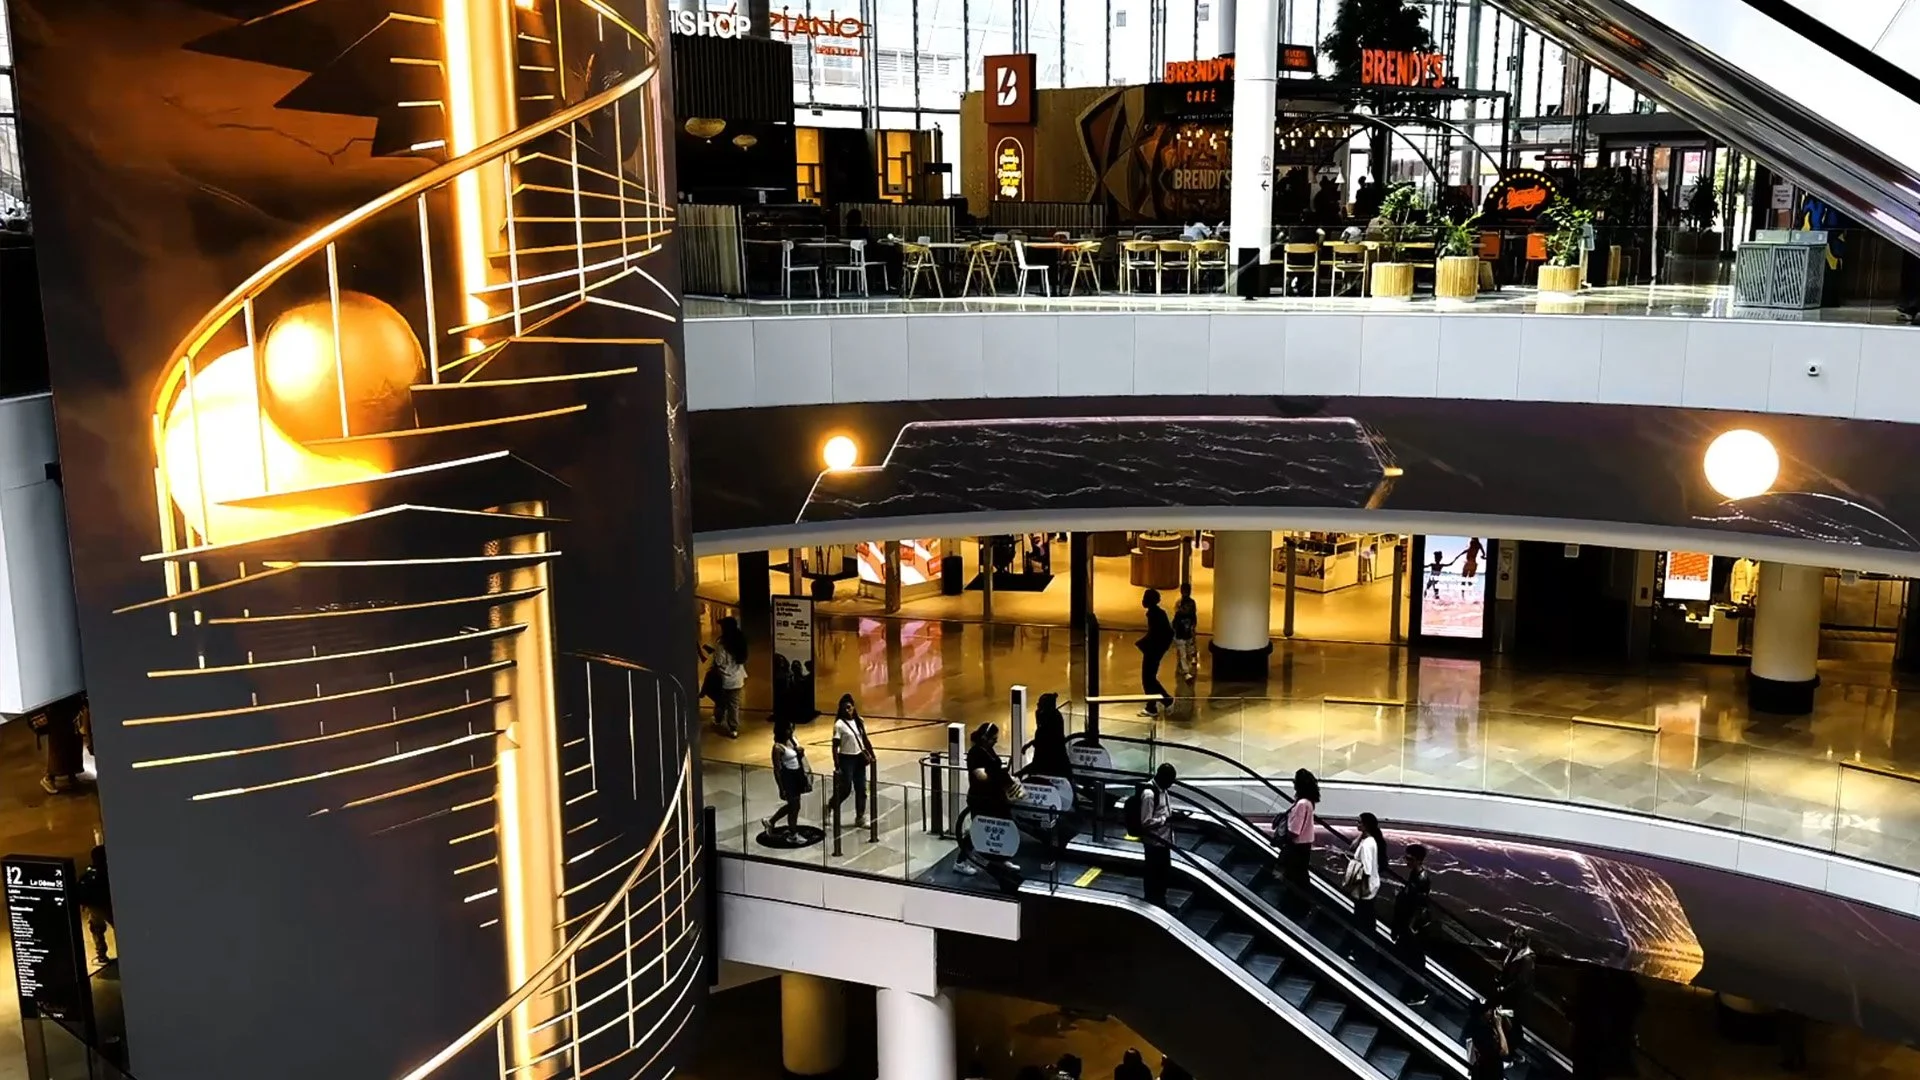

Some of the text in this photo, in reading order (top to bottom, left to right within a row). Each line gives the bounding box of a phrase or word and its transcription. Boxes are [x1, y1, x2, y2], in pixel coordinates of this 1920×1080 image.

[1165, 58, 1235, 83] BRENDY'
[1361, 48, 1444, 88] BRENDY'S
[1186, 88, 1216, 103] CAFÉ
